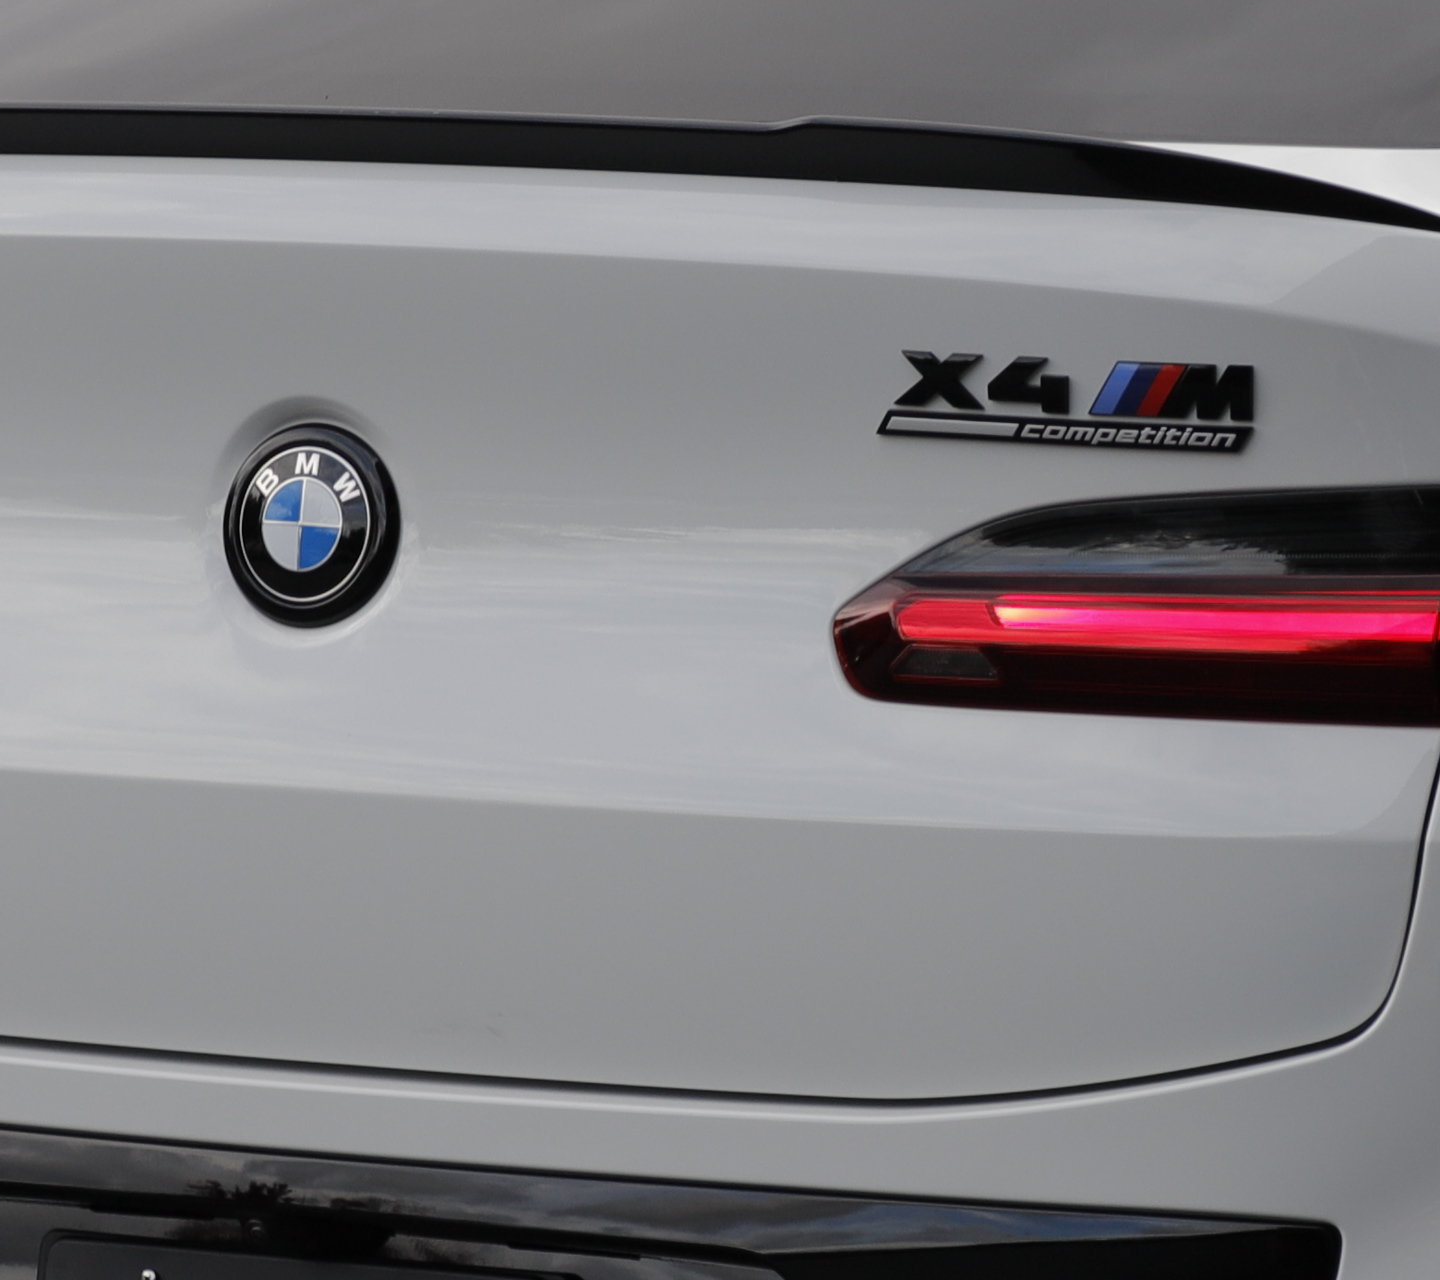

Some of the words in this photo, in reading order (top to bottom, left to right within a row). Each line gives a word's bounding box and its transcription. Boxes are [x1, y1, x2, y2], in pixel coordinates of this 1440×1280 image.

[893, 349, 1070, 416] X4
[1150, 363, 1255, 421] M
[1019, 422, 1237, 449] competition
[256, 451, 361, 503] BMW
